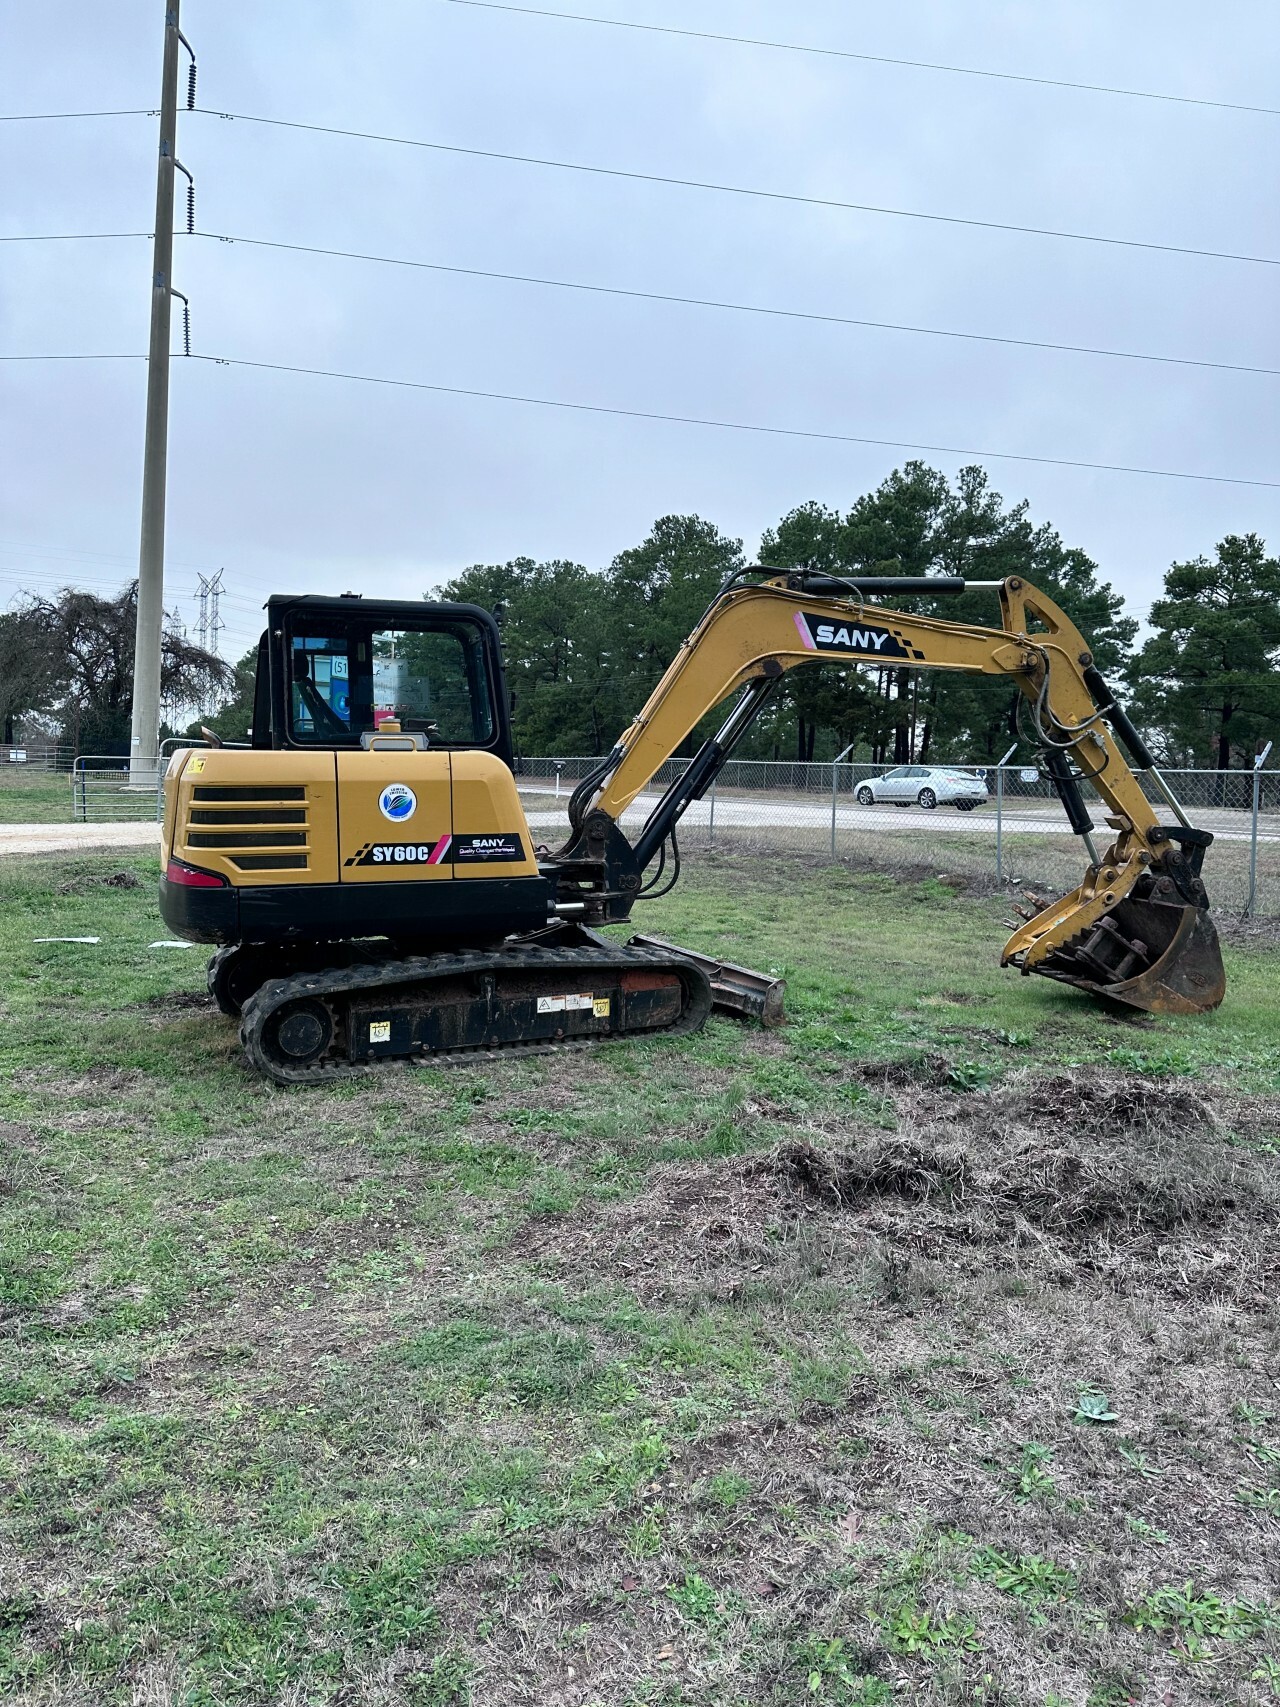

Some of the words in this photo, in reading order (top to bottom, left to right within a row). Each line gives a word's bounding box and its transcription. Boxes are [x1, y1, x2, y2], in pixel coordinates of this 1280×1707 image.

[816, 625, 888, 650] SANY
[472, 838, 505, 848] SANY
[372, 846, 429, 862] SY60C
